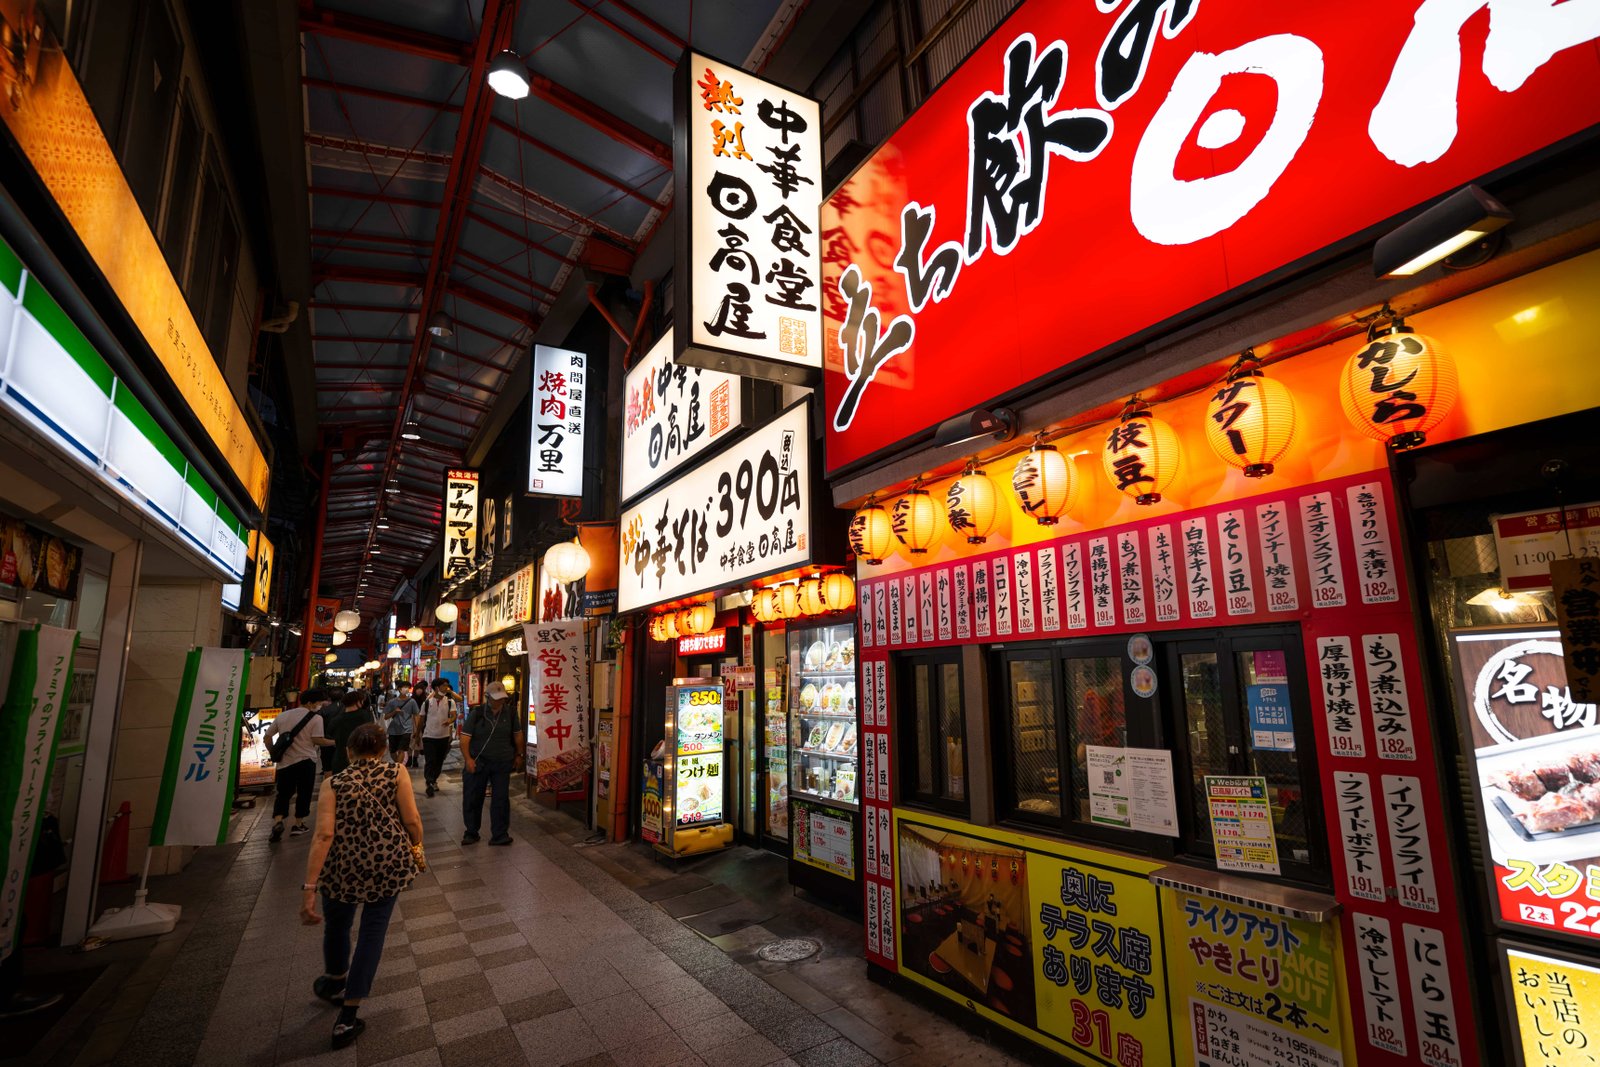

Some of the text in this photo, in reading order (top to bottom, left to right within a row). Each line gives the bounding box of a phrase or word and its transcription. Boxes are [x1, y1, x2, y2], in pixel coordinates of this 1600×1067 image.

[757, 99, 816, 311] 中華食堂
[704, 171, 766, 339] 日高屋
[568, 355, 584, 435] 肉問屋直送
[1357, 336, 1425, 424] かしら
[649, 381, 705, 468] 日高屋
[1211, 381, 1255, 455] サワー
[1107, 422, 1154, 490] 枝豆
[947, 481, 976, 533] もつ煮
[1013, 456, 1045, 514] 生ビール
[448, 482, 474, 575] アカマル屋
[622, 514, 643, 566] うまい
[634, 497, 714, 591] 中華そば
[720, 519, 797, 572] 中華食堂 日高屋
[892, 499, 910, 544] ホッピー
[1306, 501, 1337, 585] オニオンスライス
[1356, 492, 1388, 579] きゅうりの一本漬け
[1121, 540, 1141, 605] もつ煮込み
[1156, 533, 1173, 601] 生キャベツ
[1185, 527, 1210, 598] 白菜キムチ
[1223, 518, 1251, 594] そら豆
[1261, 510, 1291, 588] ウインナー焼き
[1514, 551, 1556, 566] 11:00
[939, 576, 948, 626] かしら
[975, 569, 988, 620] 唐揚げ
[996, 564, 1008, 619] コロッケ
[1016, 560, 1030, 616] 冷やしトマト
[1041, 553, 1055, 614] フライドポテト
[1066, 549, 1080, 612] イワシフライ
[1091, 544, 1110, 607] 厚揚げ焼き
[1270, 592, 1295, 605] 182円
[1315, 587, 1343, 601] 182円
[1364, 582, 1395, 597] 182円
[862, 592, 871, 633] かわ
[876, 589, 885, 630] つくね
[890, 585, 899, 631] ねぎま
[906, 584, 915, 628] シロ
[922, 580, 931, 626] レバー
[1069, 614, 1085, 624] 191円
[1096, 611, 1113, 621] 191円
[1126, 607, 1144, 619] 182円
[1157, 604, 1177, 616] 119円
[1192, 600, 1213, 613] 182円
[1229, 596, 1252, 609] 182円
[877, 665, 885, 712] ポテトサラダ
[1320, 644, 1356, 732] 厚揚げ焼き
[1369, 642, 1407, 736] もつ煮込み
[1492, 659, 1597, 729] 名物
[185, 689, 220, 782] ファミマル
[1332, 736, 1361, 751] 191円
[1380, 738, 1413, 754] 182円
[680, 763, 719, 779] つけ麺
[879, 739, 887, 786] 枝豆
[867, 812, 876, 861] そら豆
[1340, 780, 1374, 873] フライドポテト
[1387, 786, 1424, 884] イワシフライ
[1061, 867, 1117, 916] 奥に
[1350, 875, 1381, 895] 191円
[1402, 885, 1435, 904] 191円
[1040, 903, 1152, 975] テラス席
[1185, 898, 1301, 954] テイクアウト
[1525, 906, 1550, 922] 2本
[1043, 944, 1154, 1019] あります
[1188, 937, 1281, 987] やきとり
[1359, 926, 1394, 1022] 冷やしトマト
[1208, 1008, 1228, 1023] かわ
[1280, 970, 1326, 1009] OUT
[1414, 938, 1455, 1045] にら玉
[1070, 998, 1143, 1067] 31席
[1209, 1022, 1240, 1041] つくね
[1370, 1023, 1402, 1048] 182円
[1517, 967, 1561, 1067] おいしい
[1210, 1035, 1241, 1054] ねぎま
[1286, 1051, 1318, 1067] 213
